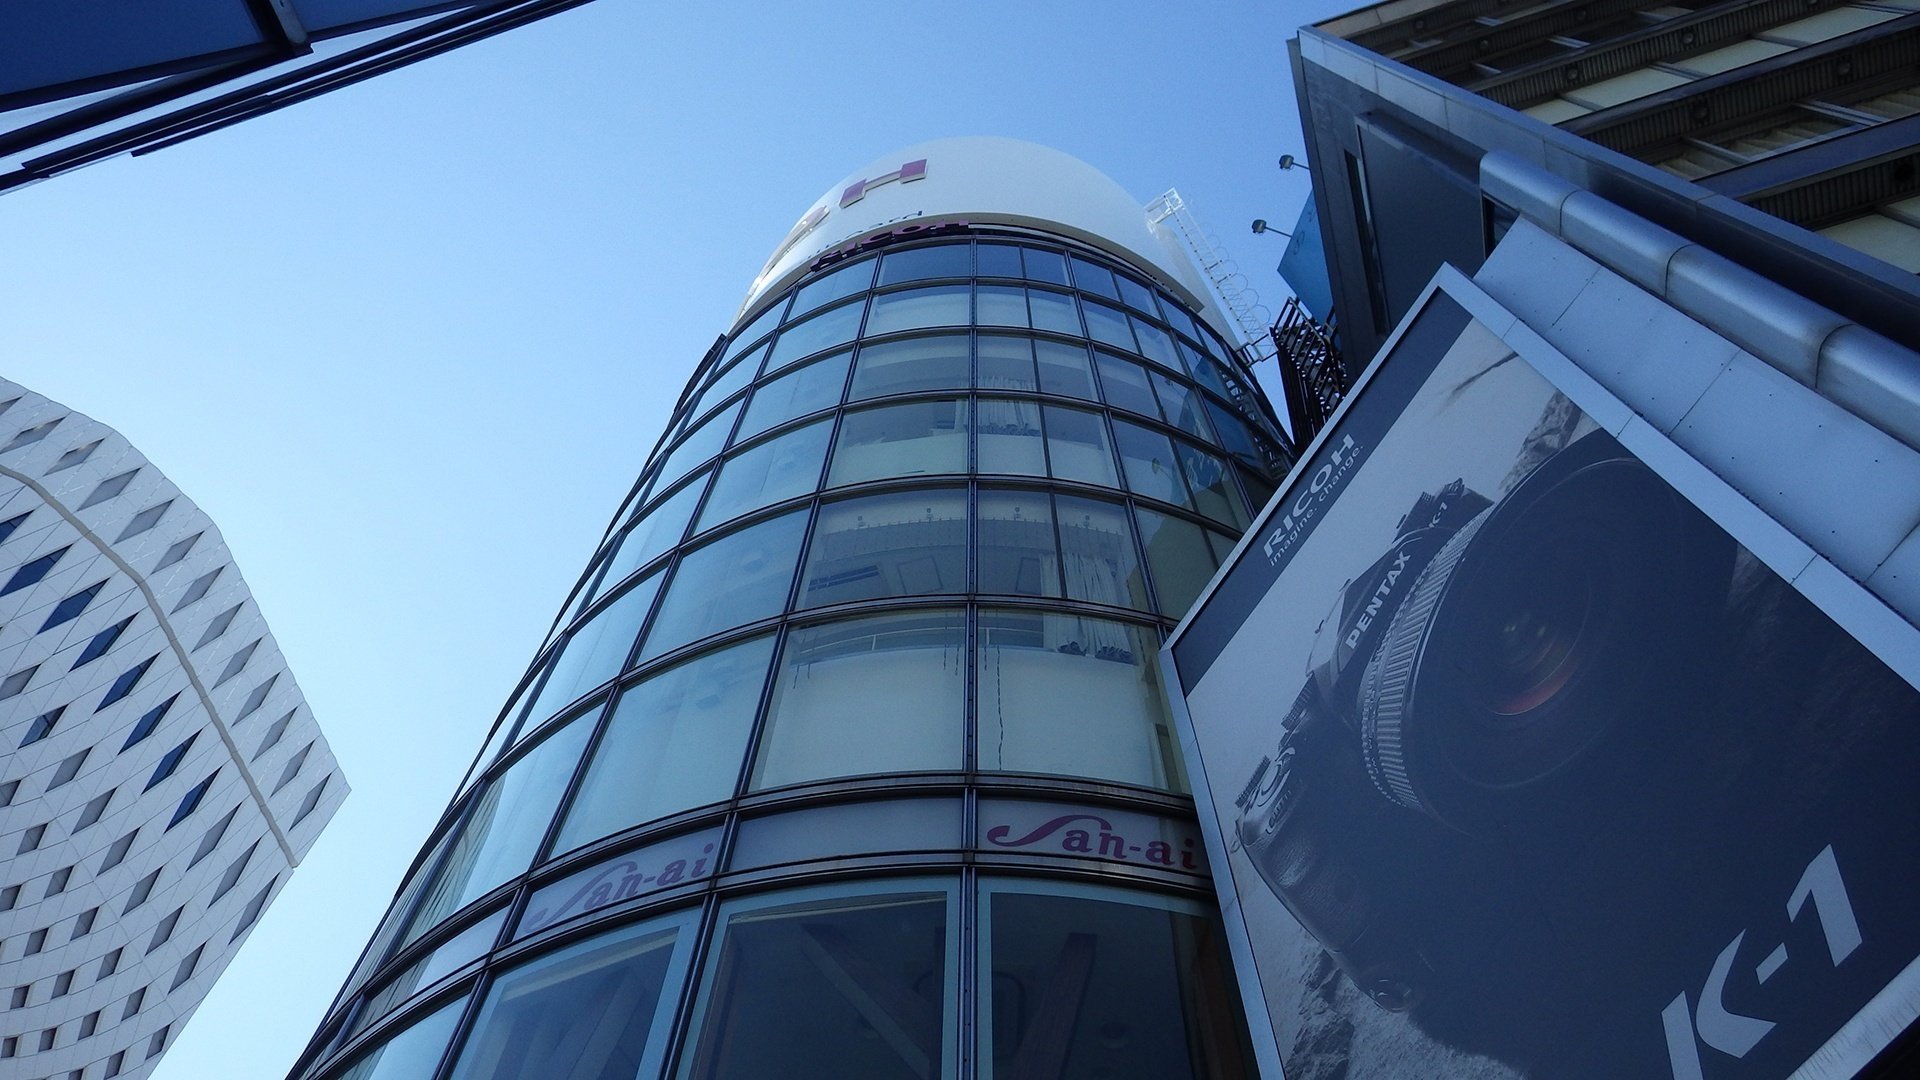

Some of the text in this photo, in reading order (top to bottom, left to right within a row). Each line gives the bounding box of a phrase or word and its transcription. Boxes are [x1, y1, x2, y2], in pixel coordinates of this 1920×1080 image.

[1263, 433, 1355, 558] RICOH
[1269, 445, 1364, 567] imagine. change.
[1345, 551, 1411, 649] PENTAX
[523, 842, 714, 932] San-ai
[986, 814, 1198, 870] San-ai
[1660, 843, 1863, 1080] K-1
